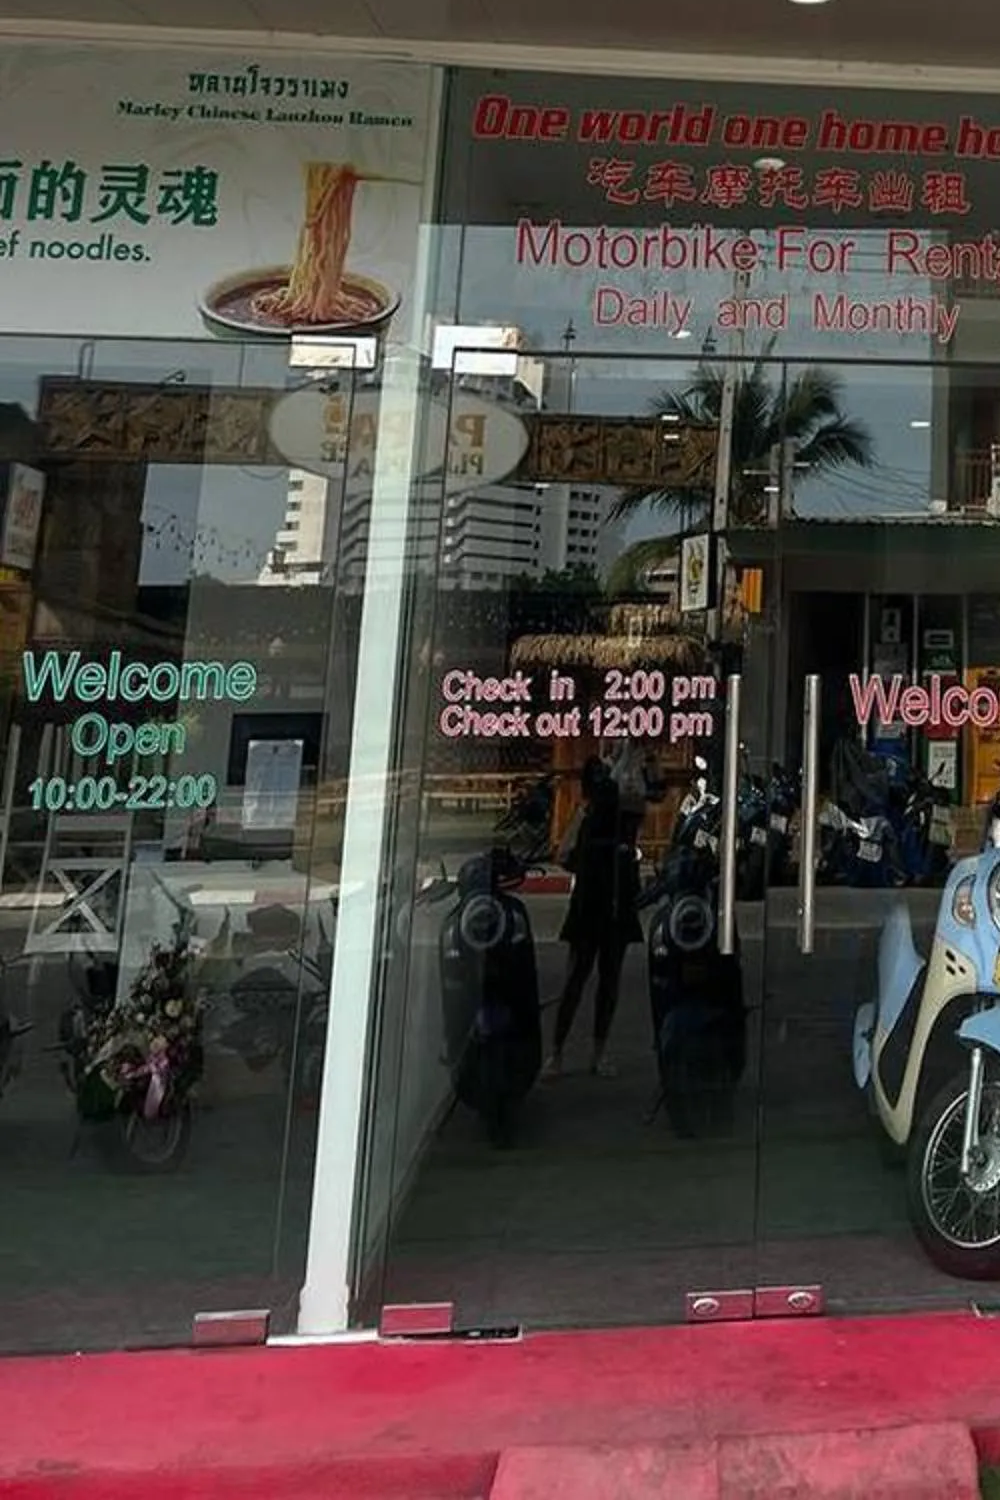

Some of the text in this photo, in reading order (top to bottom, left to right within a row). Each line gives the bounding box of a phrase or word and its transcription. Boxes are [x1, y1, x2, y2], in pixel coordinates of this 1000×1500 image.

[187, 104, 260, 122] Chinese
[265, 107, 344, 126] Lanzhou
[348, 111, 414, 128] Ramen
[472, 94, 568, 140] One
[577, 103, 713, 147] world
[721, 113, 809, 150] one
[817, 108, 950, 155] home
[29, 232, 152, 262] noodles.
[514, 218, 766, 272] Motorbike
[776, 226, 855, 273] For
[592, 286, 961, 344] Daily and Monthly
[22, 651, 257, 702] Welcome
[441, 669, 717, 707] Check in 2:00 pm
[71, 712, 186, 765] Open
[439, 704, 714, 744] Check out 12:00 pm
[28, 773, 217, 811] 10:00-22:00
